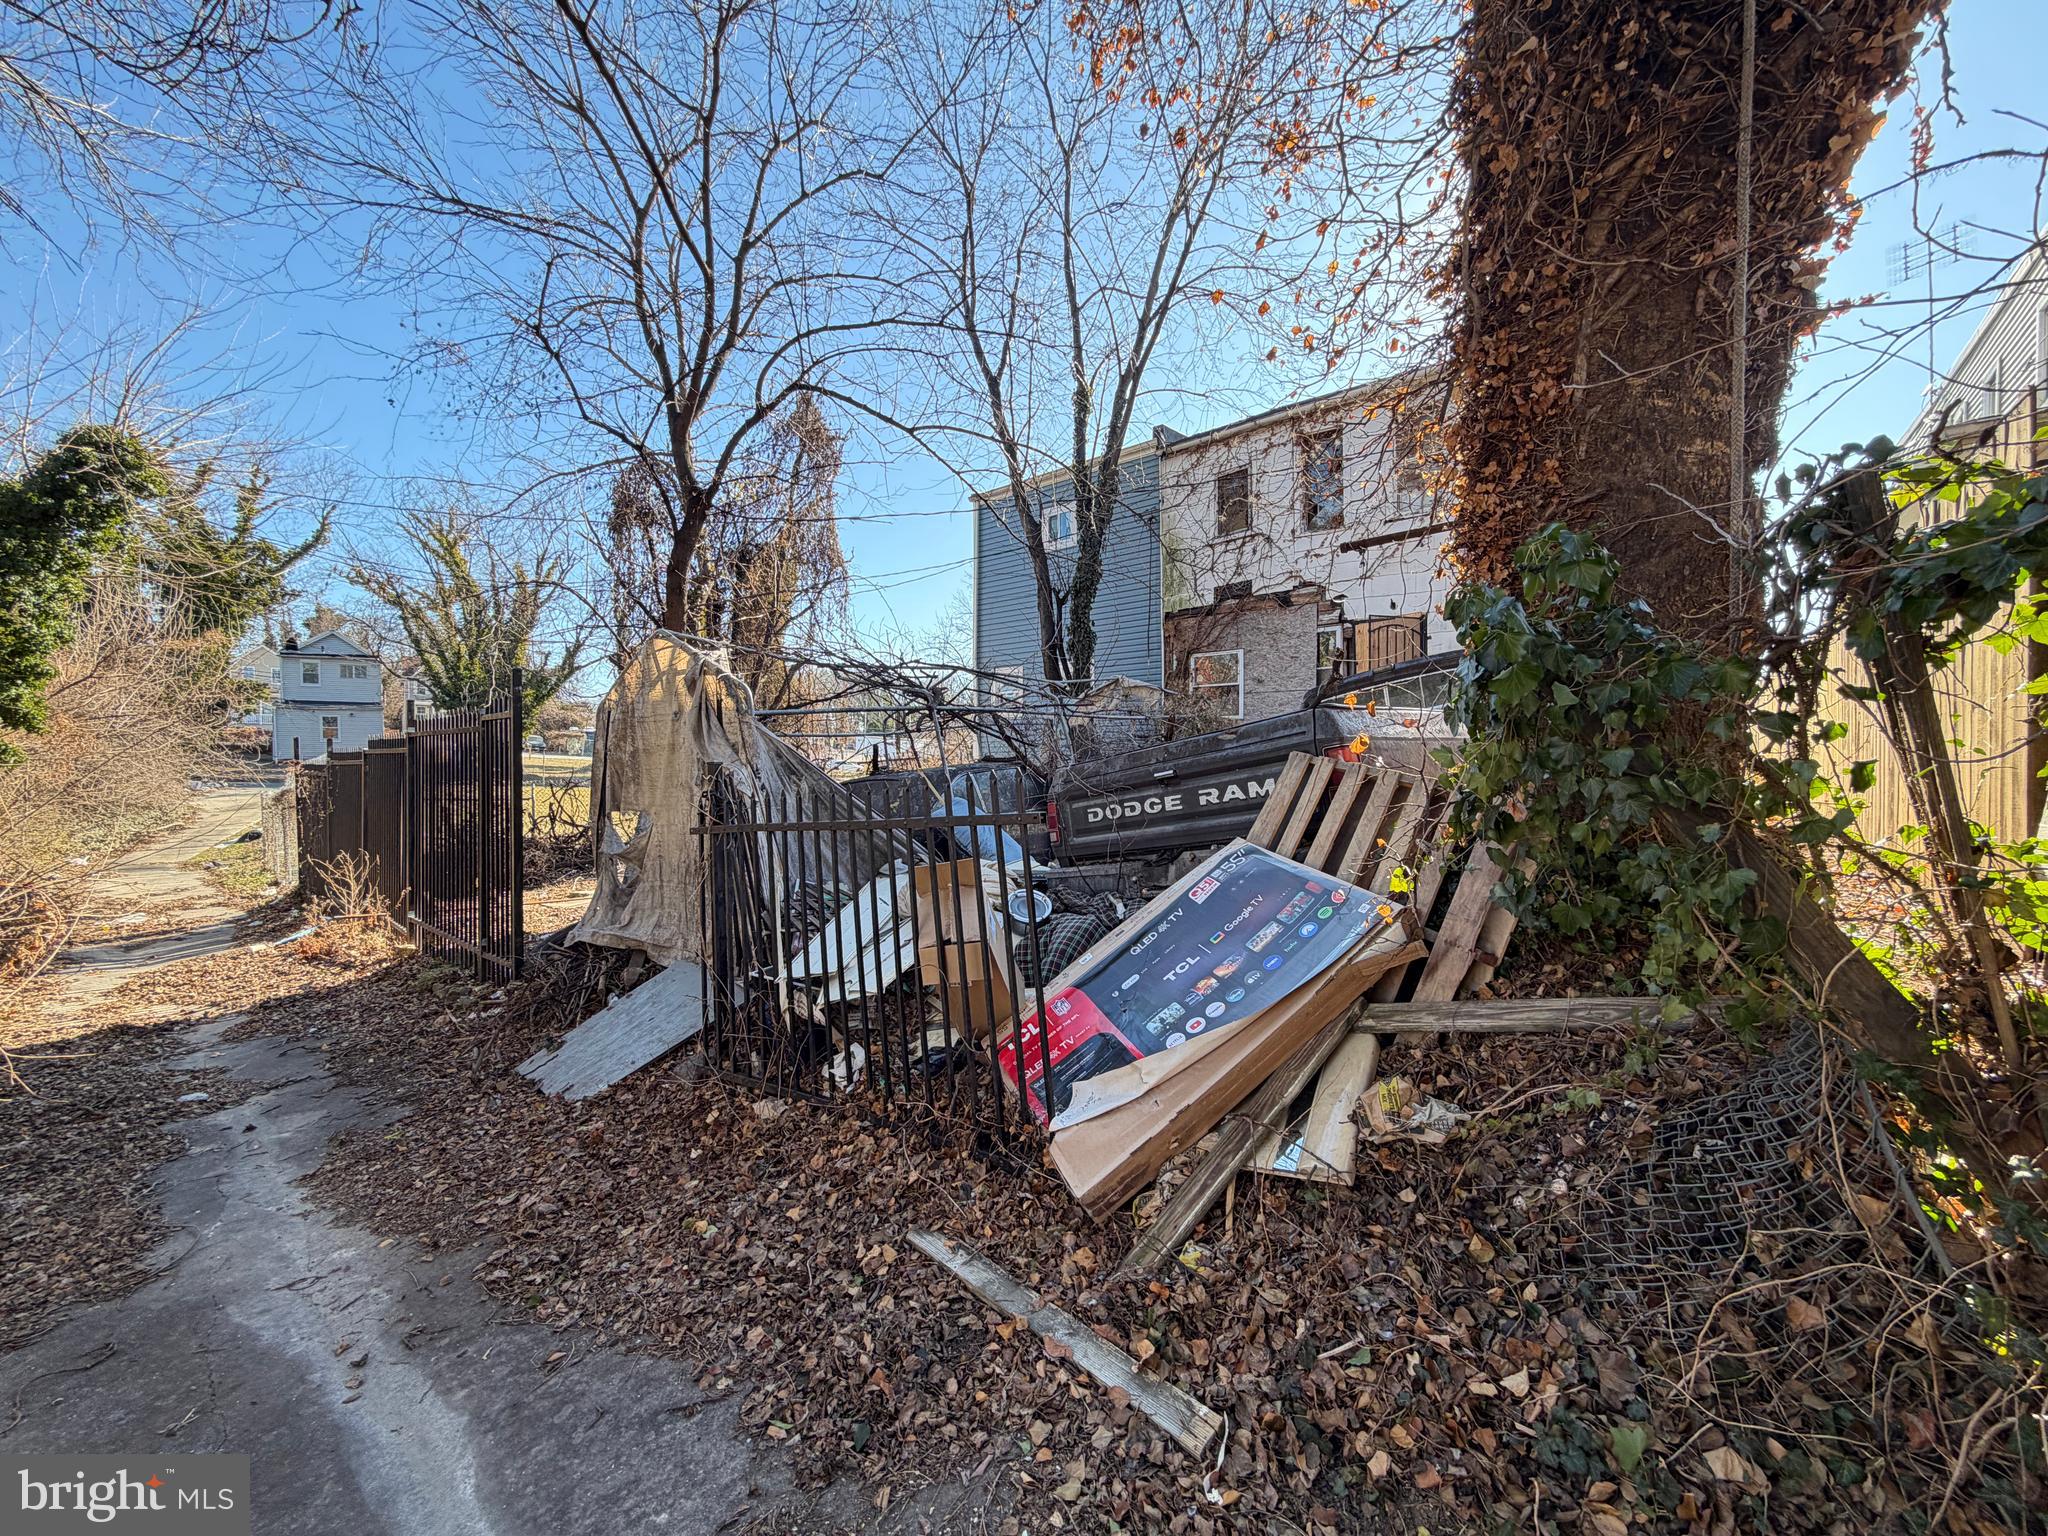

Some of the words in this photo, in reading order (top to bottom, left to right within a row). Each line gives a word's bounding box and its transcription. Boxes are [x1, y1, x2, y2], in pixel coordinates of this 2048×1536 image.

[1087, 795, 1183, 822] DODGE
[1198, 778, 1275, 806] RAM
[1224, 905, 1253, 931] Google
[1250, 894, 1264, 906] TV
[1130, 932, 1158, 955] QLED
[1168, 908, 1183, 921] TV
[1163, 956, 1200, 981] TCL
[1060, 1036, 1074, 1049] TV
